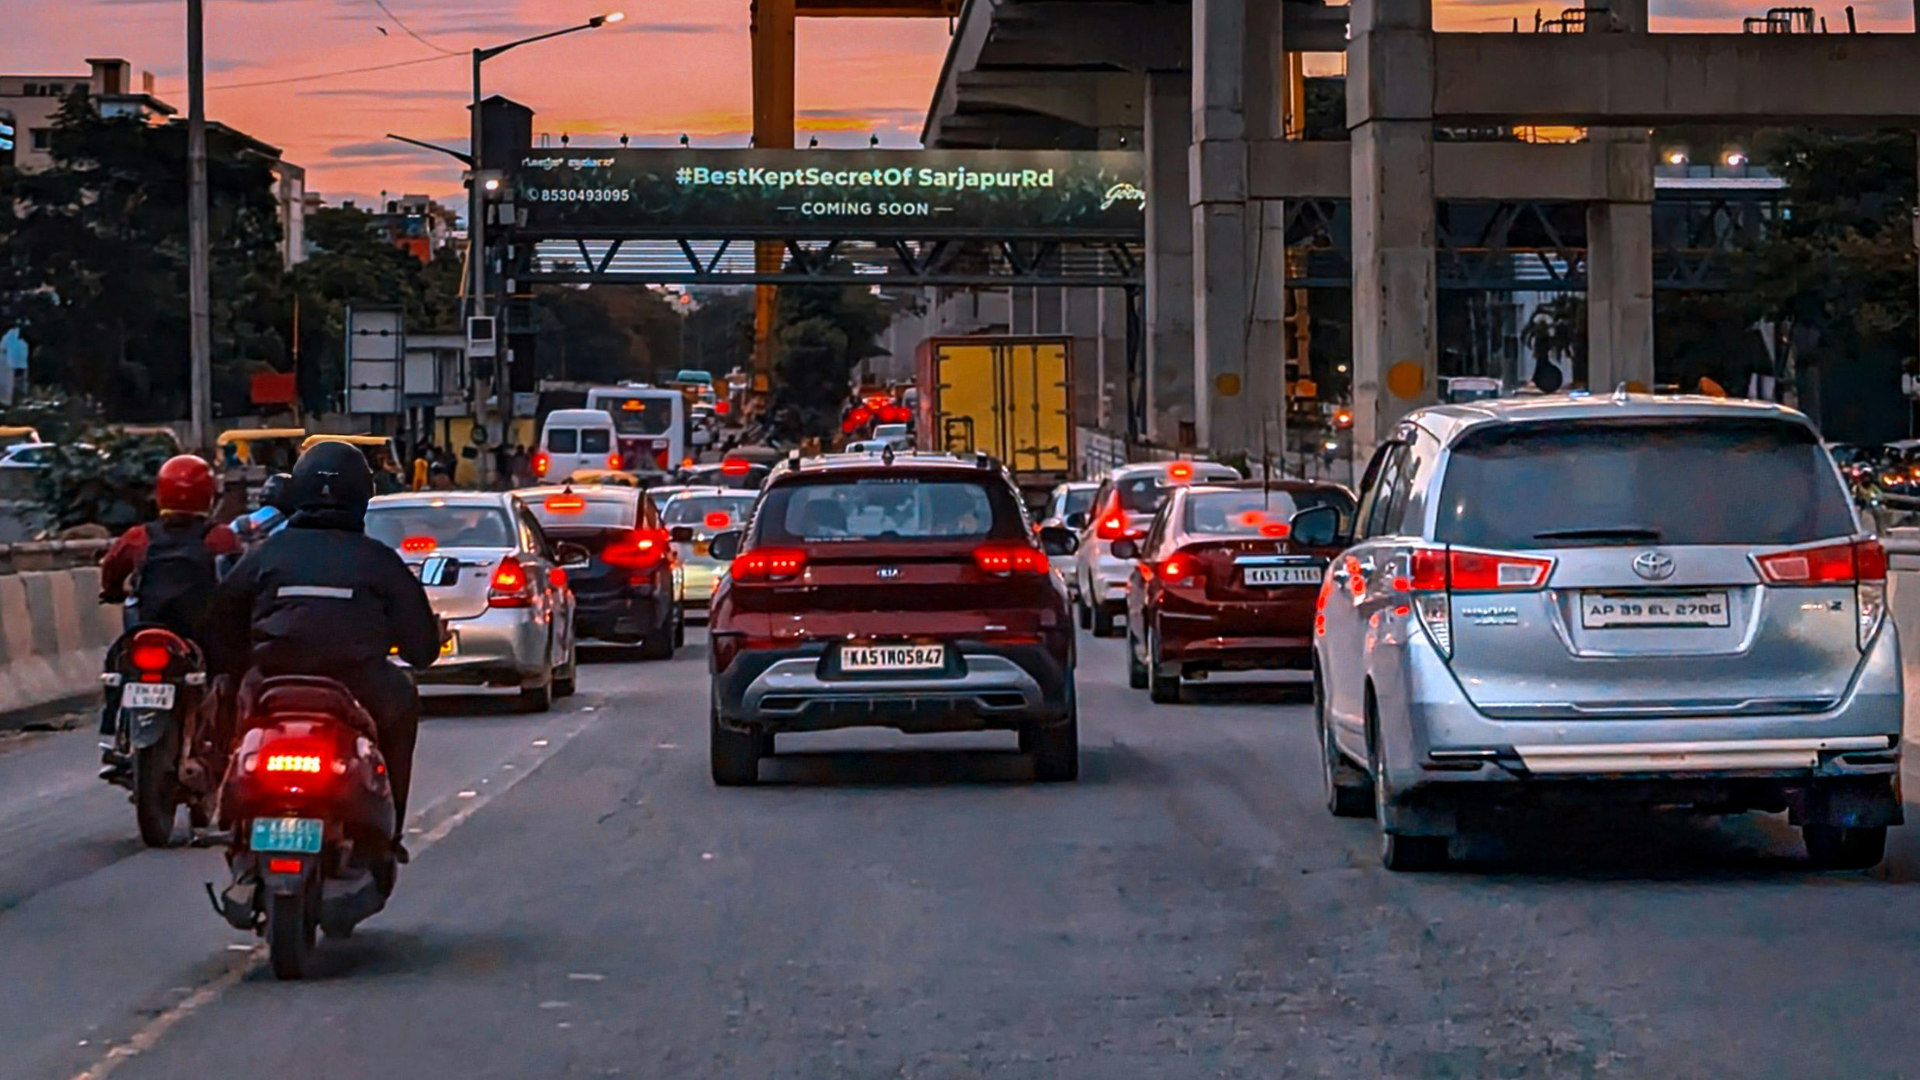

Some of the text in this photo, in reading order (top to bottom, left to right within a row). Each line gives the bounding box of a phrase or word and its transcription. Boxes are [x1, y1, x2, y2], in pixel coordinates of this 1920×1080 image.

[676, 166, 1055, 191] #BestKeptSecretOf SarjapurRd
[541, 189, 630, 202] 8530493095
[801, 202, 929, 215] COMING SOON
[1590, 605, 1615, 616] AP
